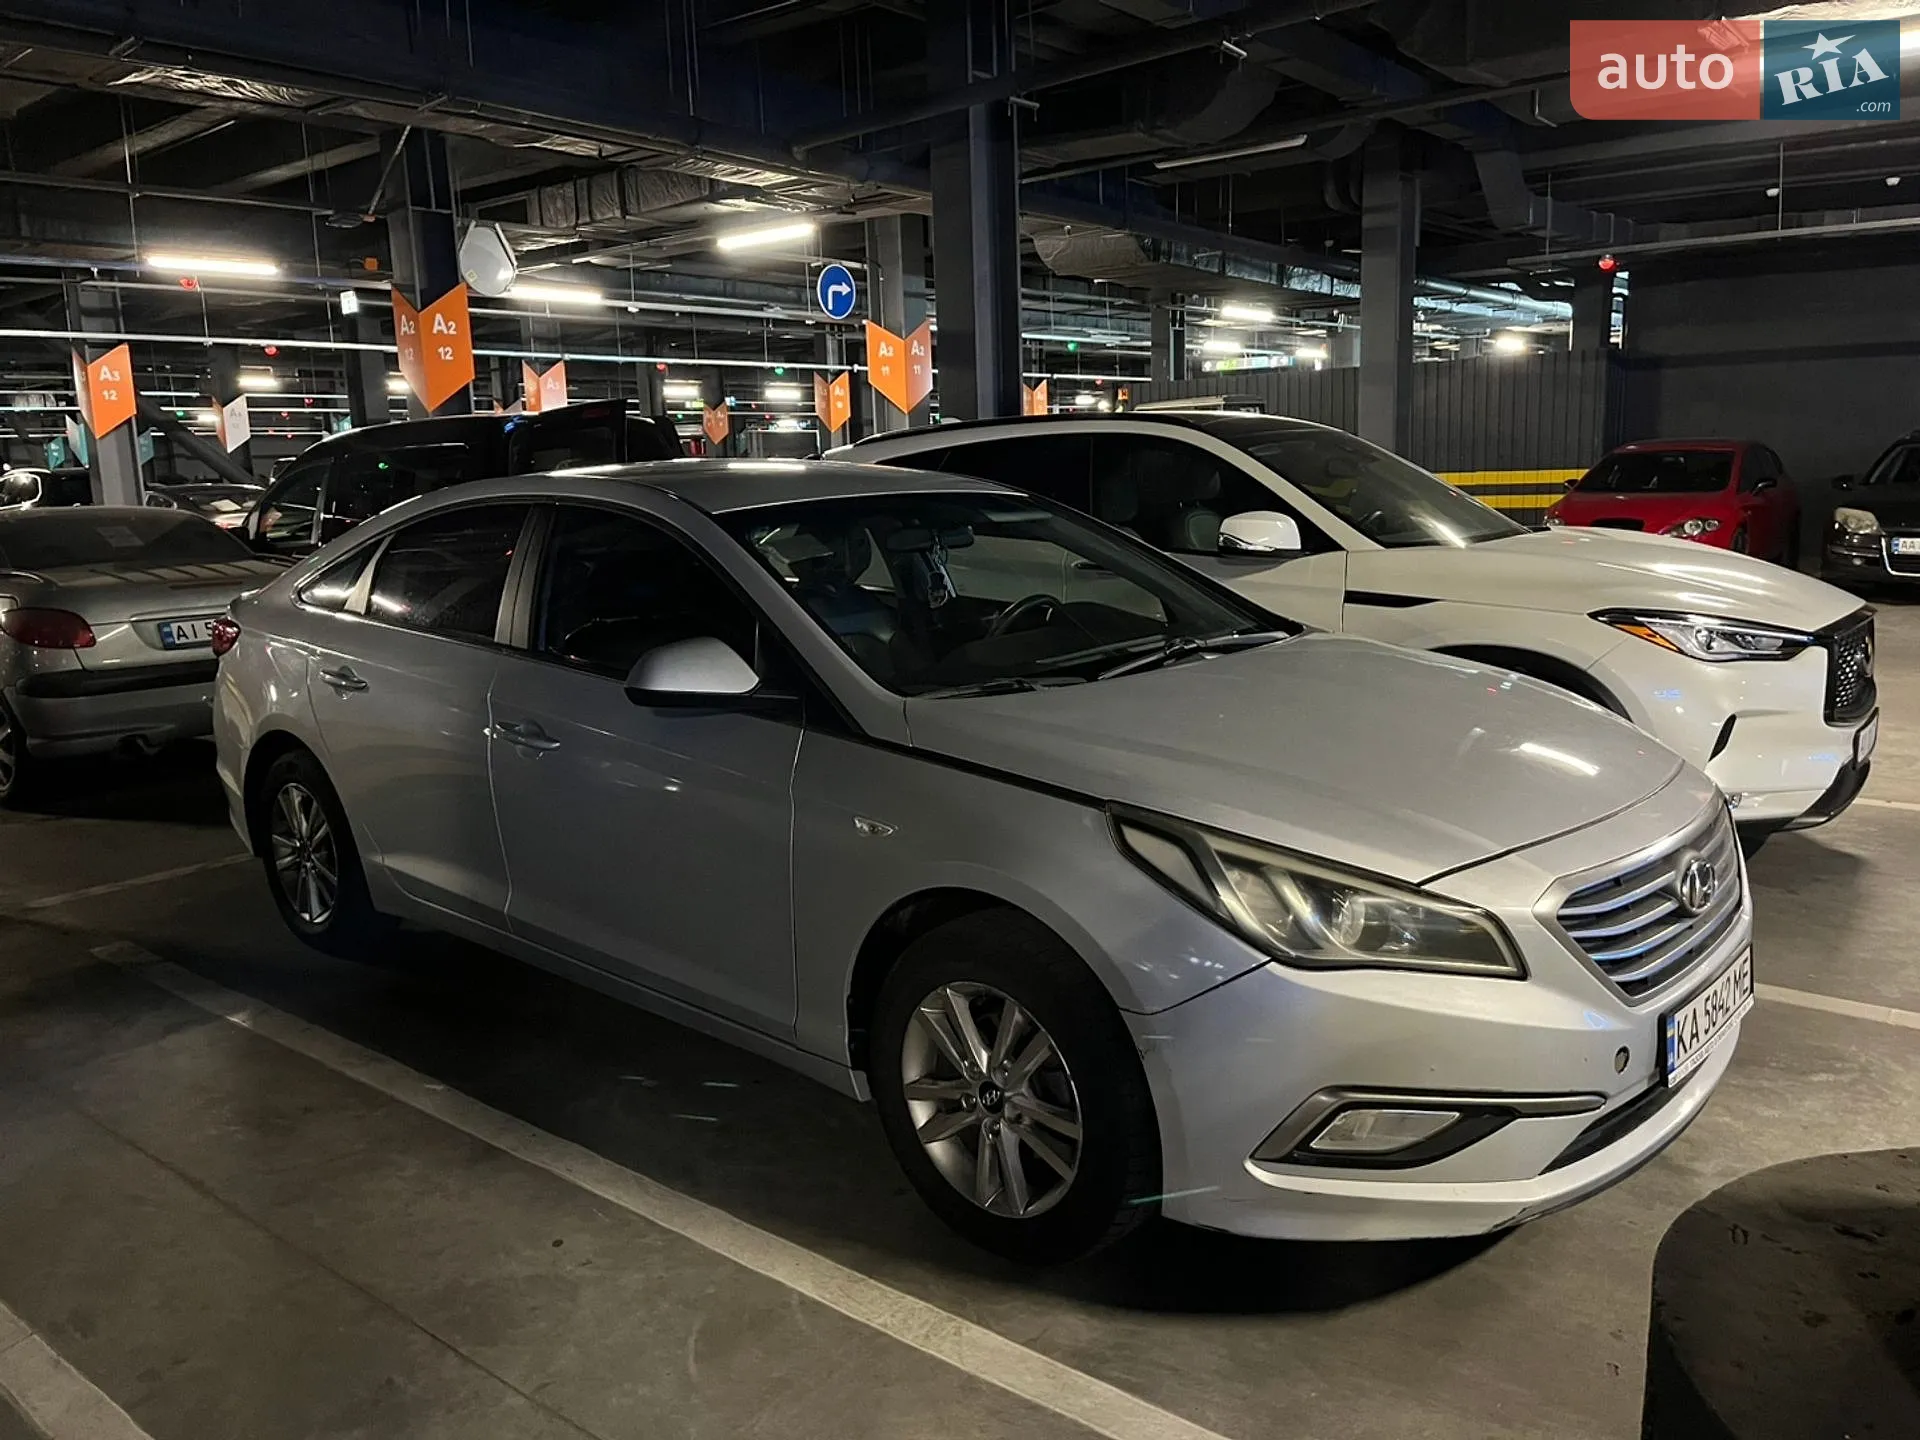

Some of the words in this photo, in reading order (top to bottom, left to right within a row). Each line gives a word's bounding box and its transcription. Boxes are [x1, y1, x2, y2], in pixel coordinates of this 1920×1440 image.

[400, 314, 415, 336] A2
[432, 312, 457, 335] A2
[437, 346, 454, 360] 12
[911, 340, 925, 356] A2
[99, 365, 120, 381] A3
[102, 389, 118, 400] 12
[177, 623, 198, 640] AI
[1677, 1007, 1700, 1059] KA
[1704, 975, 1730, 1035] 5842
